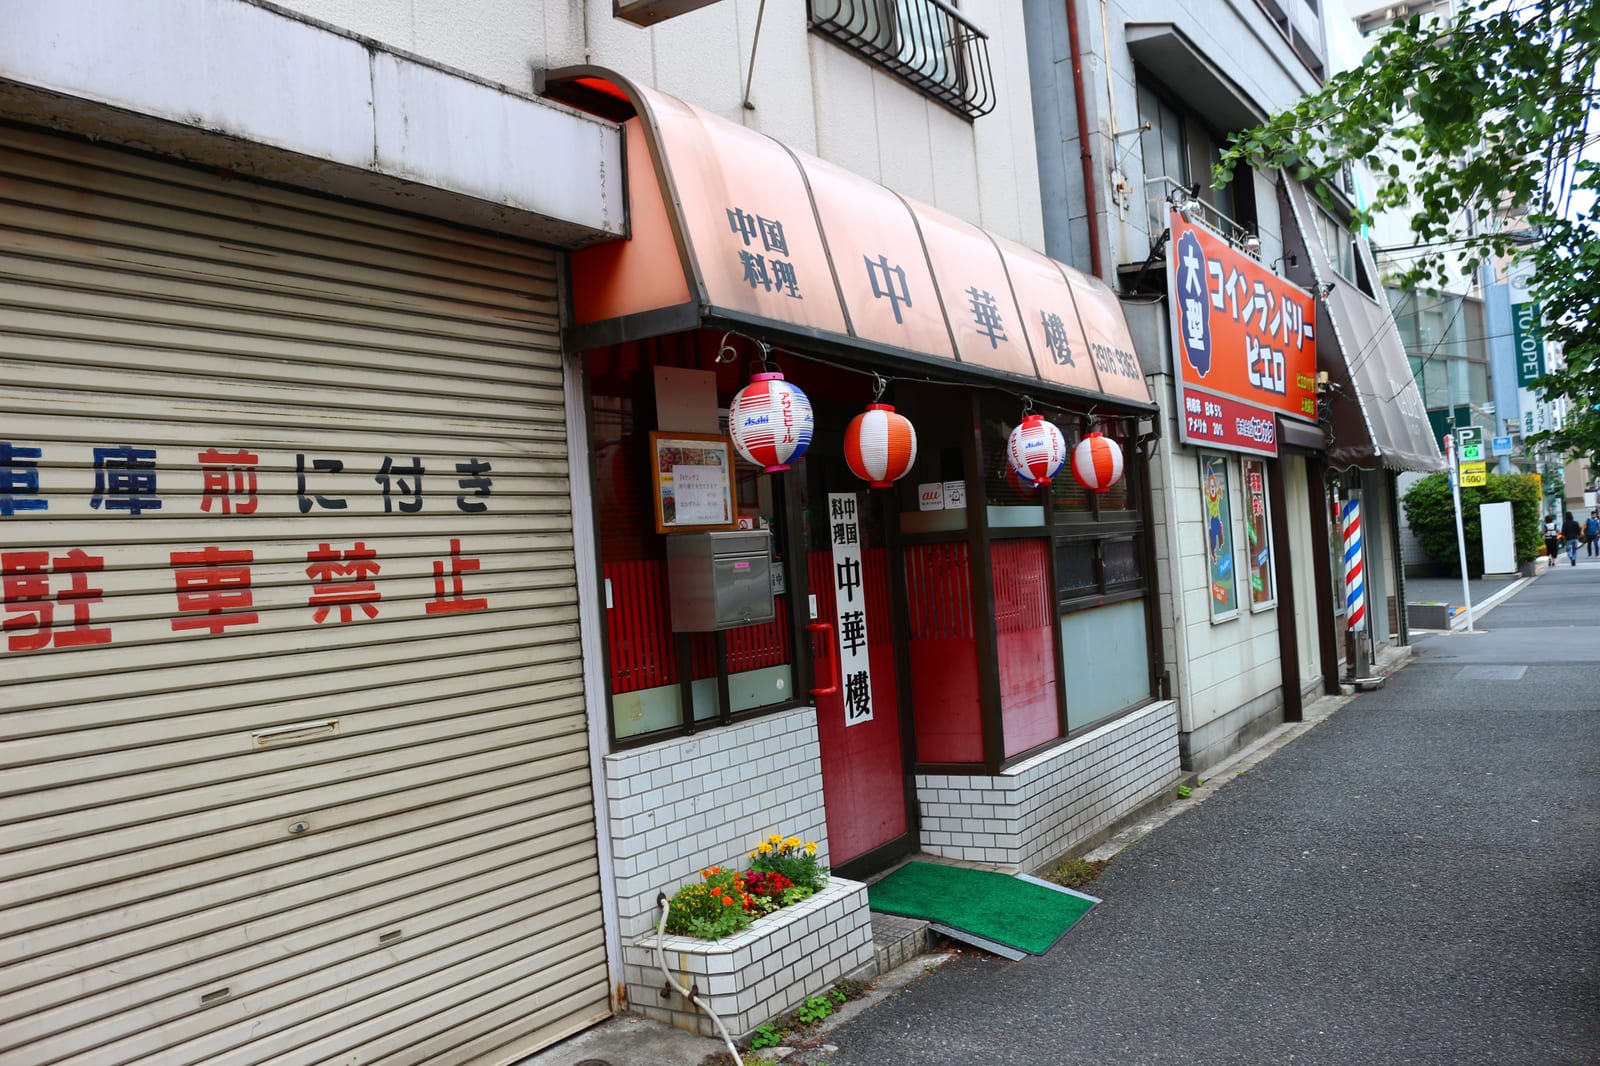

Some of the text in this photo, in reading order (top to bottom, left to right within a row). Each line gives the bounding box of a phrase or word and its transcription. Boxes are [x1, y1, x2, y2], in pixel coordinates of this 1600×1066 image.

[726, 207, 789, 257] 中国
[738, 250, 803, 300] 料理
[1183, 245, 1205, 351] 大型
[1207, 260, 1313, 351] コインランドリー
[1246, 335, 1286, 395] ピエロ
[744, 415, 769, 426] Asahi
[779, 391, 794, 444] アサヒビール
[1460, 430, 1474, 446] P
[922, 490, 941, 501] au
[2, 538, 488, 651] 駐車禁止
